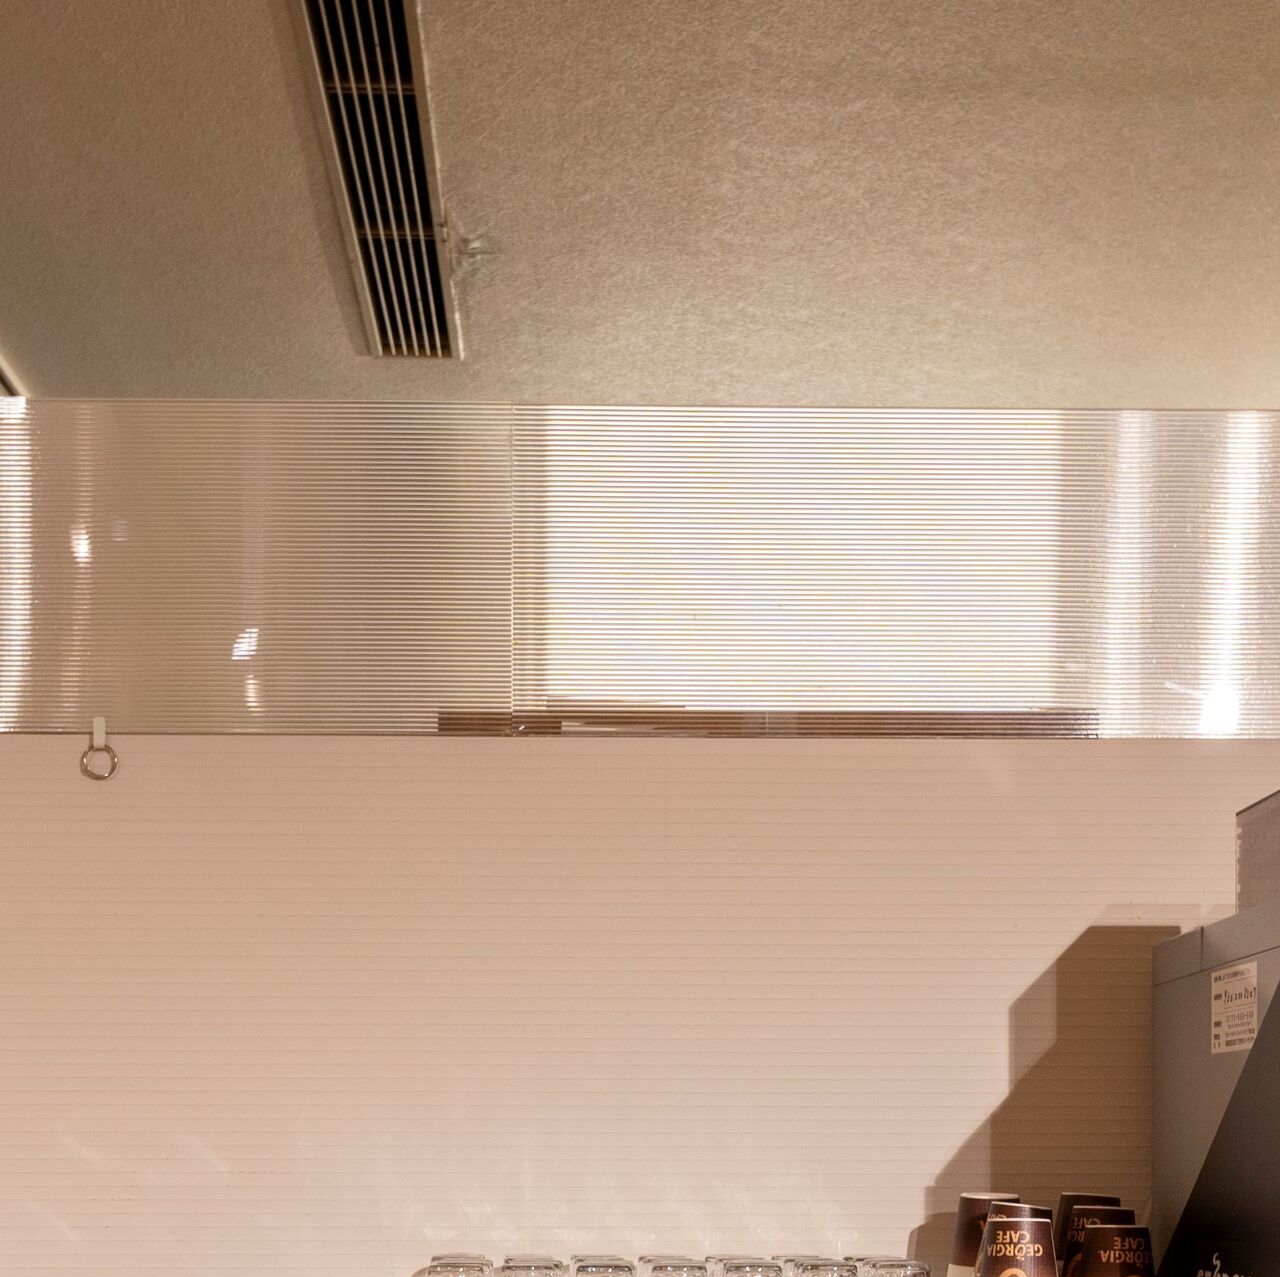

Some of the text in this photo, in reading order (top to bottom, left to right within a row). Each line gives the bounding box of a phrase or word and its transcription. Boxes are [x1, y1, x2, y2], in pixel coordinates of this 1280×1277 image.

[996, 1230, 1030, 1244] CAFE
[1114, 1237, 1145, 1250] CAFE
[987, 1243, 1043, 1260] GEORGIA
